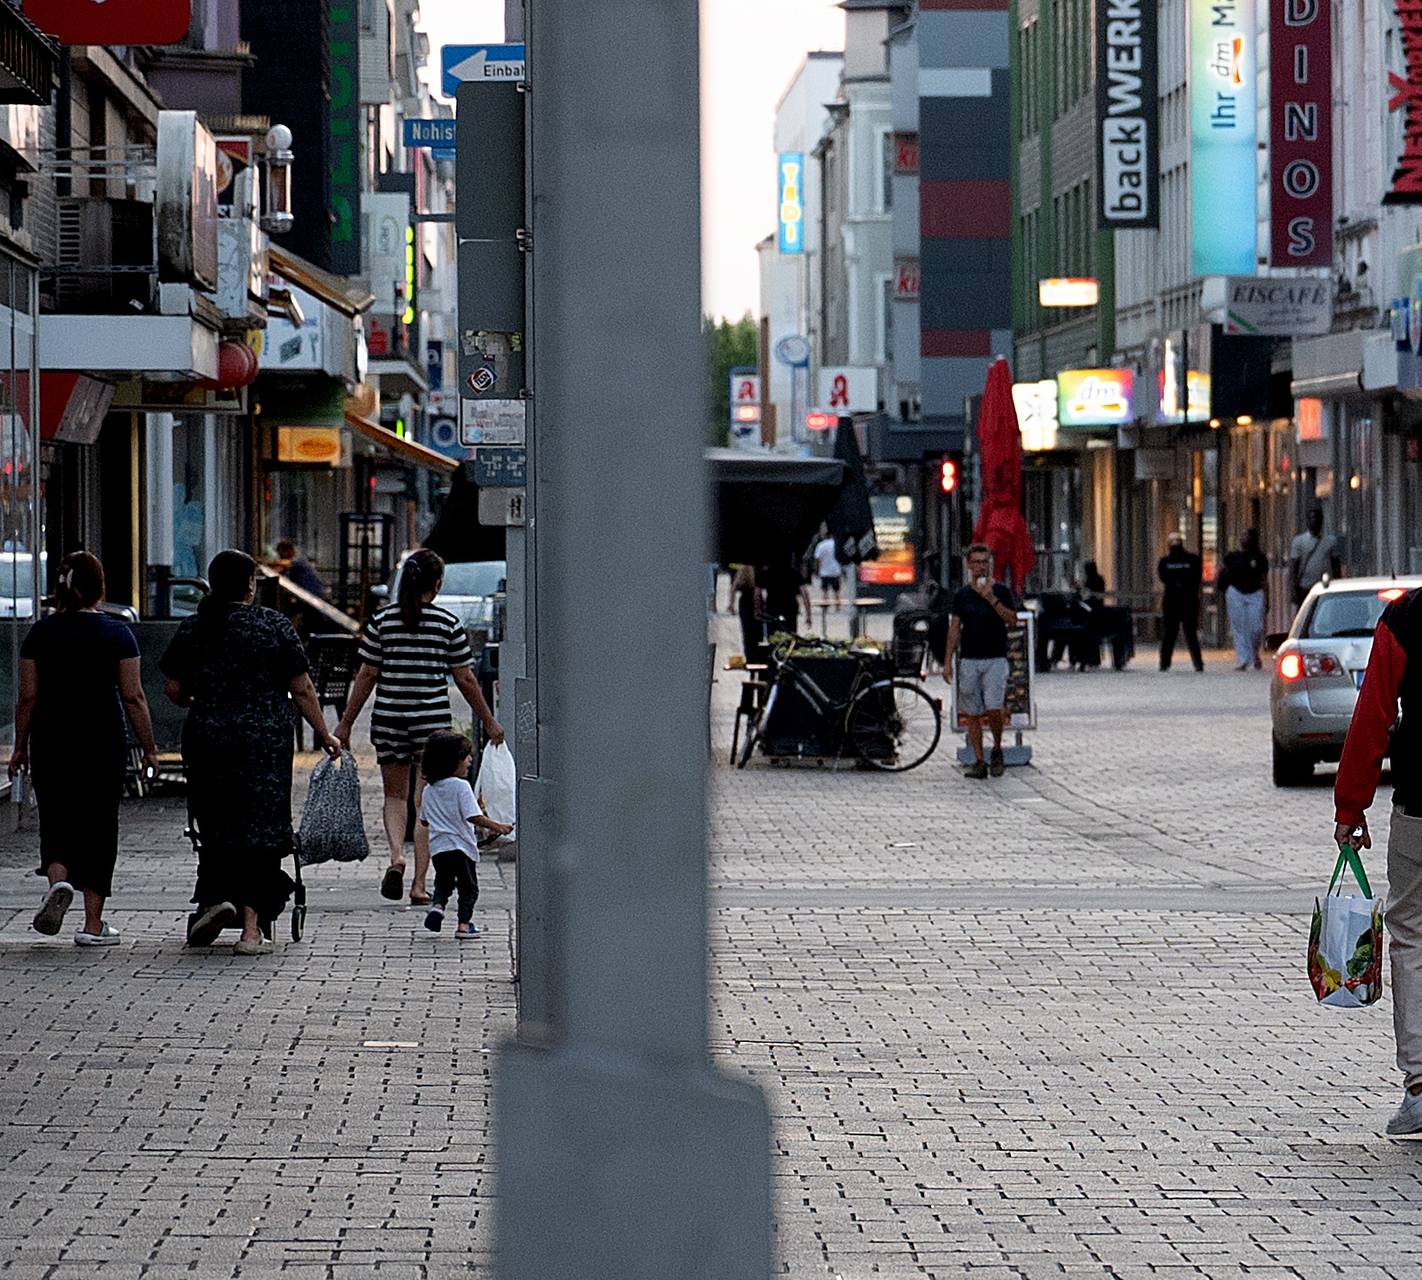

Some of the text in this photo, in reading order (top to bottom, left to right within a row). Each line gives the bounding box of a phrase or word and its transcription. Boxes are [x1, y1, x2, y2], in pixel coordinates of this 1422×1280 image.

[1210, 0, 1236, 129] Ihr dm M
[1283, 0, 1320, 256] DINOS
[412, 122, 456, 141] Nohls
